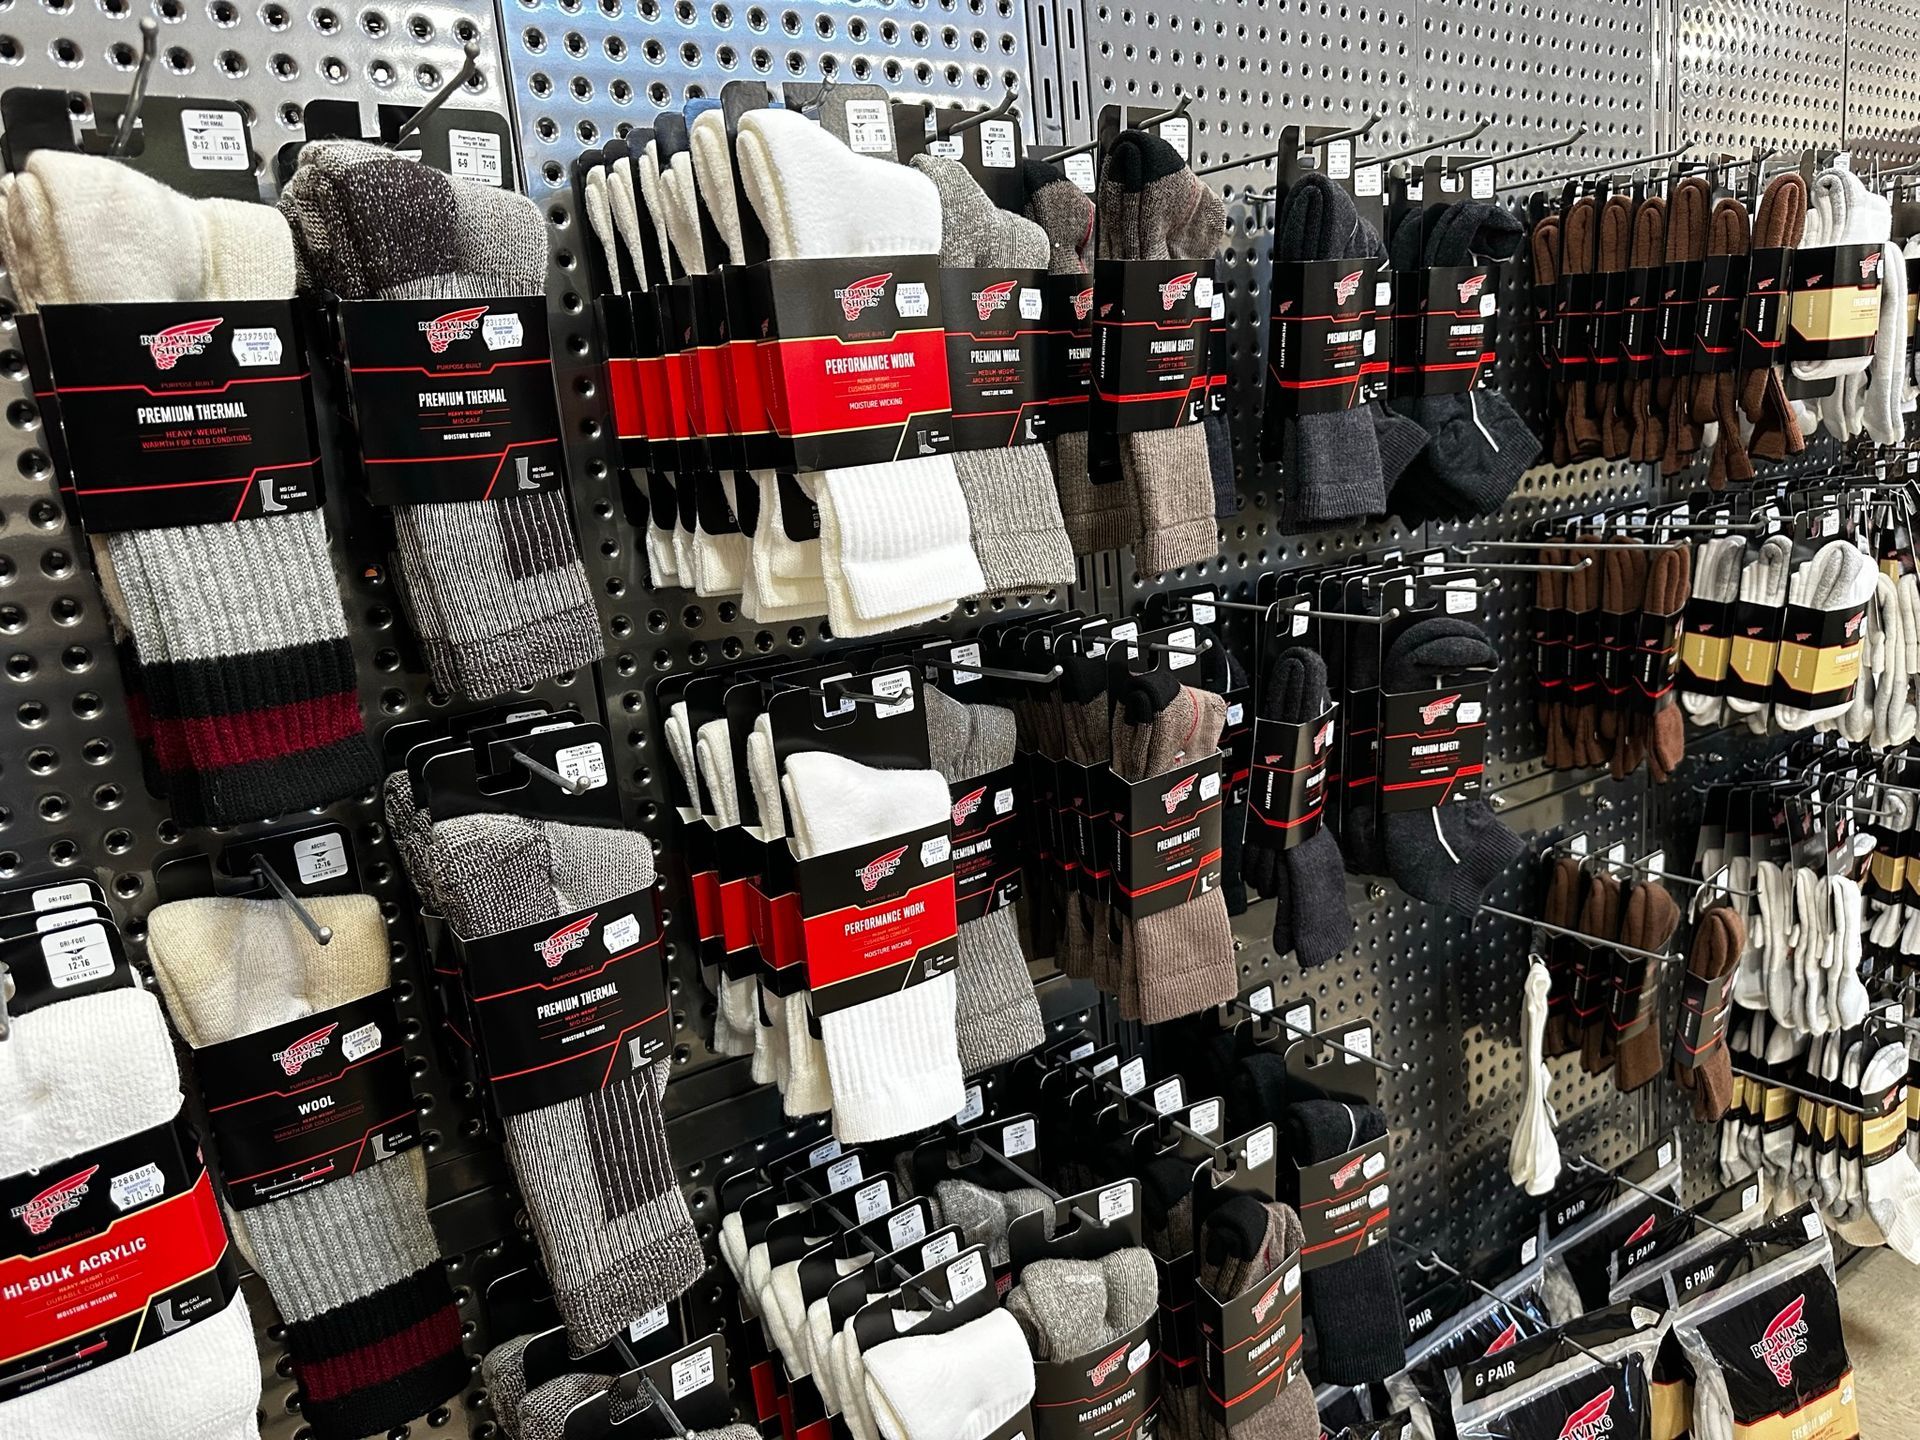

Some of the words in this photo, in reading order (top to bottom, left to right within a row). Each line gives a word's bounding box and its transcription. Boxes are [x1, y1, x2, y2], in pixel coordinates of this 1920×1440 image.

[221, 142, 240, 150] 10-13
[458, 159, 468, 168] 6-9
[483, 161, 496, 169] 7-10
[834, 290, 854, 299] RED
[857, 287, 884, 298] WING
[972, 292, 989, 301] RED
[991, 292, 1011, 301] WING
[846, 298, 877, 307] SHOES
[419, 322, 443, 331] RED
[447, 321, 479, 330] WING
[140, 335, 169, 345] RED
[174, 333, 212, 343] WING
[432, 331, 471, 340] SHOES
[1327, 332, 1348, 344] PREMIUM
[1349, 330, 1362, 342] SAFETY
[157, 345, 203, 355] SHOES
[1151, 341, 1177, 354] PREMIUM
[1178, 339, 1194, 352] SAFETY
[241, 353, 247, 362] $
[826, 357, 890, 375] PERFORMANCE
[891, 352, 915, 368] WORK
[970, 350, 1001, 363] PREMIUM
[1002, 349, 1020, 362] WORK
[848, 384, 876, 392] CUSHIONED
[878, 382, 900, 390] COMFORT
[1002, 375, 1020, 383] COMFORT
[419, 391, 464, 407] PREMIUM
[465, 389, 507, 403] THERMAL
[849, 400, 878, 410] MOISTURE
[879, 398, 902, 407] WICKING
[137, 405, 195, 424] PREMIUM
[196, 402, 247, 420] THERMAL
[166, 428, 227, 437] HEAVY-WEIGHT
[192, 438, 211, 446] COLD
[213, 435, 252, 444] CONDITIONS
[879, 678, 903, 687] PERFORMANCE
[1412, 744, 1439, 756] PREMIUM
[1440, 741, 1459, 752] SAFETY
[567, 768, 579, 778] 9-12
[589, 762, 604, 772] 10-13
[311, 841, 327, 850] ARCTIC
[1157, 833, 1182, 852] PREMIUM
[1183, 826, 1200, 843] SAFETY
[952, 843, 975, 860] REMIUM
[976, 839, 991, 853] WORK
[315, 860, 331, 870] 12-16
[855, 866, 874, 876] RED
[874, 859, 900, 871] WING
[864, 868, 895, 880] SHOES
[48, 893, 73, 903] DRI-FOOT
[845, 909, 902, 936] PERFORMANCE
[903, 901, 926, 918] WORK
[60, 936, 86, 948] DRI-FOOT
[534, 939, 557, 952] RED
[558, 928, 590, 944] WING
[547, 939, 582, 955] SHOES
[864, 945, 890, 958] MOISTURE
[891, 939, 912, 950] WICKING
[68, 959, 91, 971] 12-16
[553, 964, 594, 982] PURPOSE-BUILT
[66, 974, 81, 982] MADE
[88, 969, 99, 977] USA
[537, 992, 579, 1020] PREMIUM
[580, 982, 618, 1005] THERMAL
[569, 1014, 595, 1027] MID-CALF
[561, 1030, 585, 1044] MOISTURE
[586, 1024, 606, 1036] WICKING
[272, 1049, 294, 1061] RED
[296, 1038, 330, 1053] WING
[285, 1049, 323, 1064] SHOES
[349, 1050, 354, 1058] $
[359, 1039, 379, 1054] 15.00
[298, 1095, 335, 1115] WOOL
[274, 1128, 300, 1140] WARMTH
[301, 1124, 313, 1133] FOR
[314, 1119, 330, 1129] COLD
[331, 1104, 365, 1124] CONDITIONS
[112, 1166, 156, 1189] 22888050
[269, 1189, 289, 1199] Suggested
[290, 1184, 311, 1194] Temperature
[312, 1179, 325, 1188] Range
[11, 1200, 43, 1218] RED
[47, 1185, 89, 1206] WING
[31, 1198, 80, 1220] SHOES
[1325, 1203, 1350, 1219] PREMIUM
[1350, 1195, 1367, 1210] SAFETY
[1557, 1212, 1564, 1224] 6
[1565, 1200, 1585, 1219] PAIR
[1628, 1252, 1634, 1265] 6
[3, 1265, 75, 1300] HI-BULK
[79, 1237, 147, 1275] ACRYLIC
[1685, 1277, 1692, 1290] 6
[1694, 1265, 1715, 1285] PAIR
[46, 1288, 82, 1306] DURABLE
[84, 1274, 120, 1293] COMFORT
[59, 1273, 103, 1293] HEAVY-WEIGHT
[56, 1302, 89, 1320] MOISTURE
[90, 1291, 118, 1307] WICKING
[179, 1295, 200, 1309] MID-CALF
[181, 1306, 193, 1315] FULL
[193, 1297, 212, 1311] CUSHION
[1408, 1309, 1433, 1332] PAIR
[1750, 1338, 1775, 1358] RED
[1775, 1321, 1809, 1344] WING
[1248, 1337, 1271, 1361] PREMIUM
[1770, 1339, 1807, 1366] SHOES
[20, 1377, 46, 1391] Suggested
[47, 1365, 77, 1381] Temperature
[78, 1360, 93, 1370] Range
[679, 1375, 692, 1385] 12-15
[701, 1365, 710, 1374] N/A
[1475, 1371, 1484, 1387] 6
[1487, 1361, 1516, 1383] PAIR
[1079, 1402, 1112, 1422] MERINO
[1114, 1388, 1136, 1407] WOOL
[1817, 1408, 1833, 1425] WORK
[1571, 1416, 1614, 1438] WING
